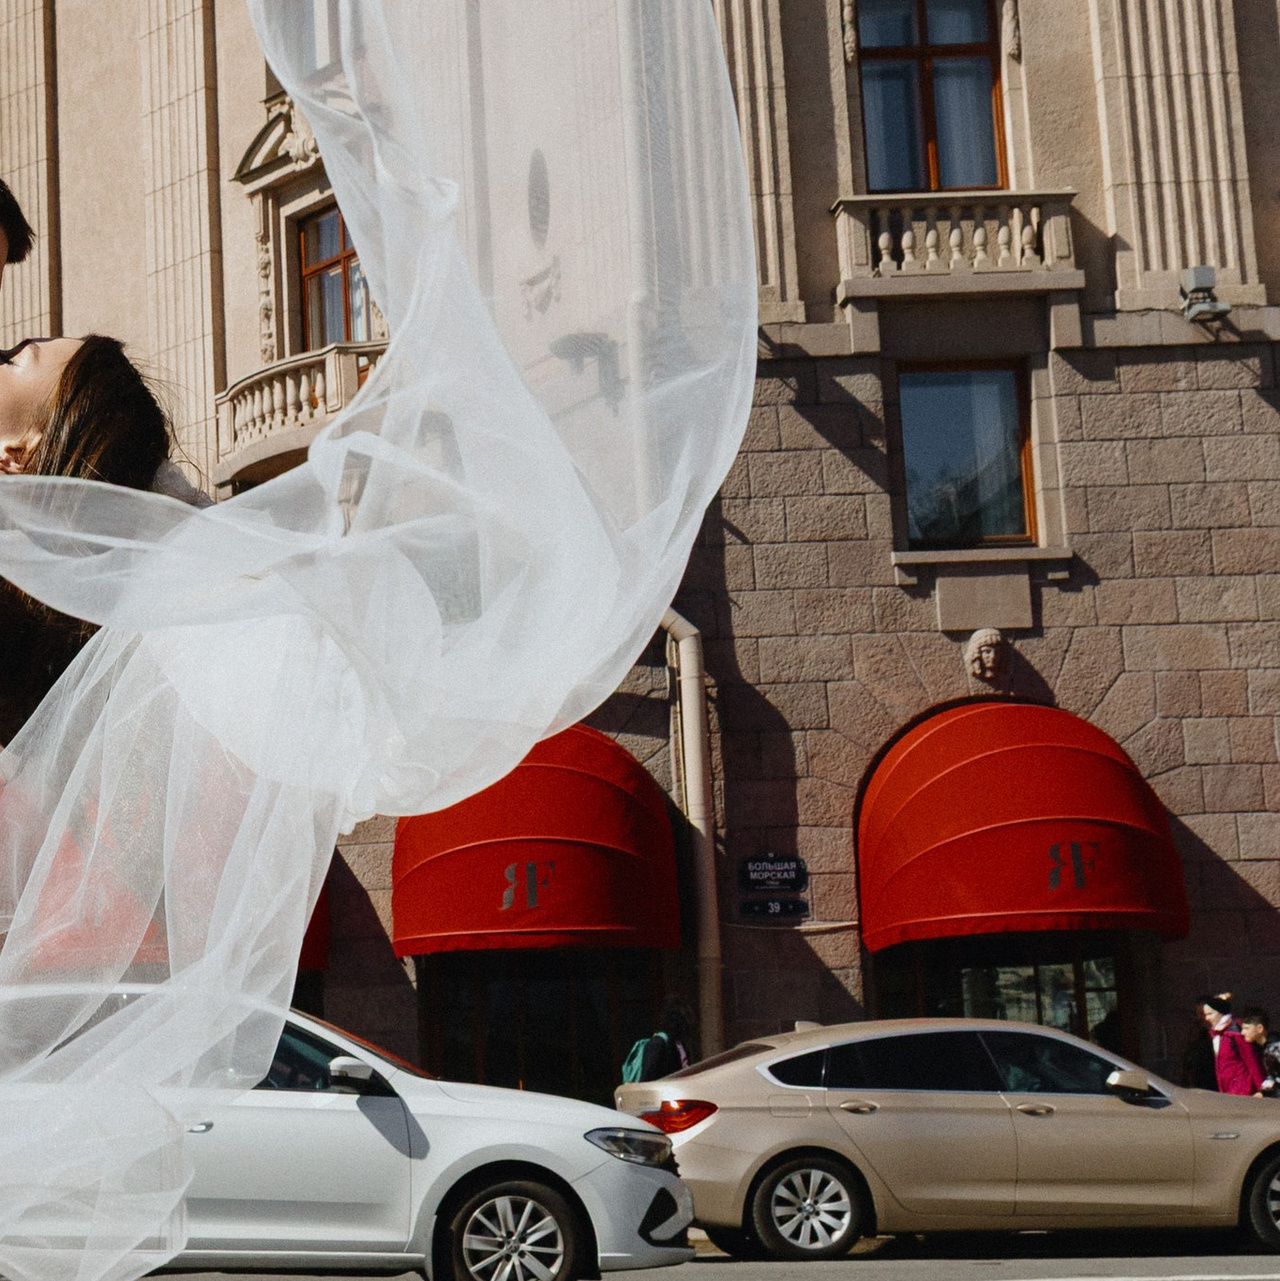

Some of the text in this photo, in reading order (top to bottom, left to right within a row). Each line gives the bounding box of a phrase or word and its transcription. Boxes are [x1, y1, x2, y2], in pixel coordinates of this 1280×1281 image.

[748, 862, 797, 871] БОЛЬШАЯ
[749, 871, 796, 880] МОРСКАЯ
[768, 902, 781, 913] 39
